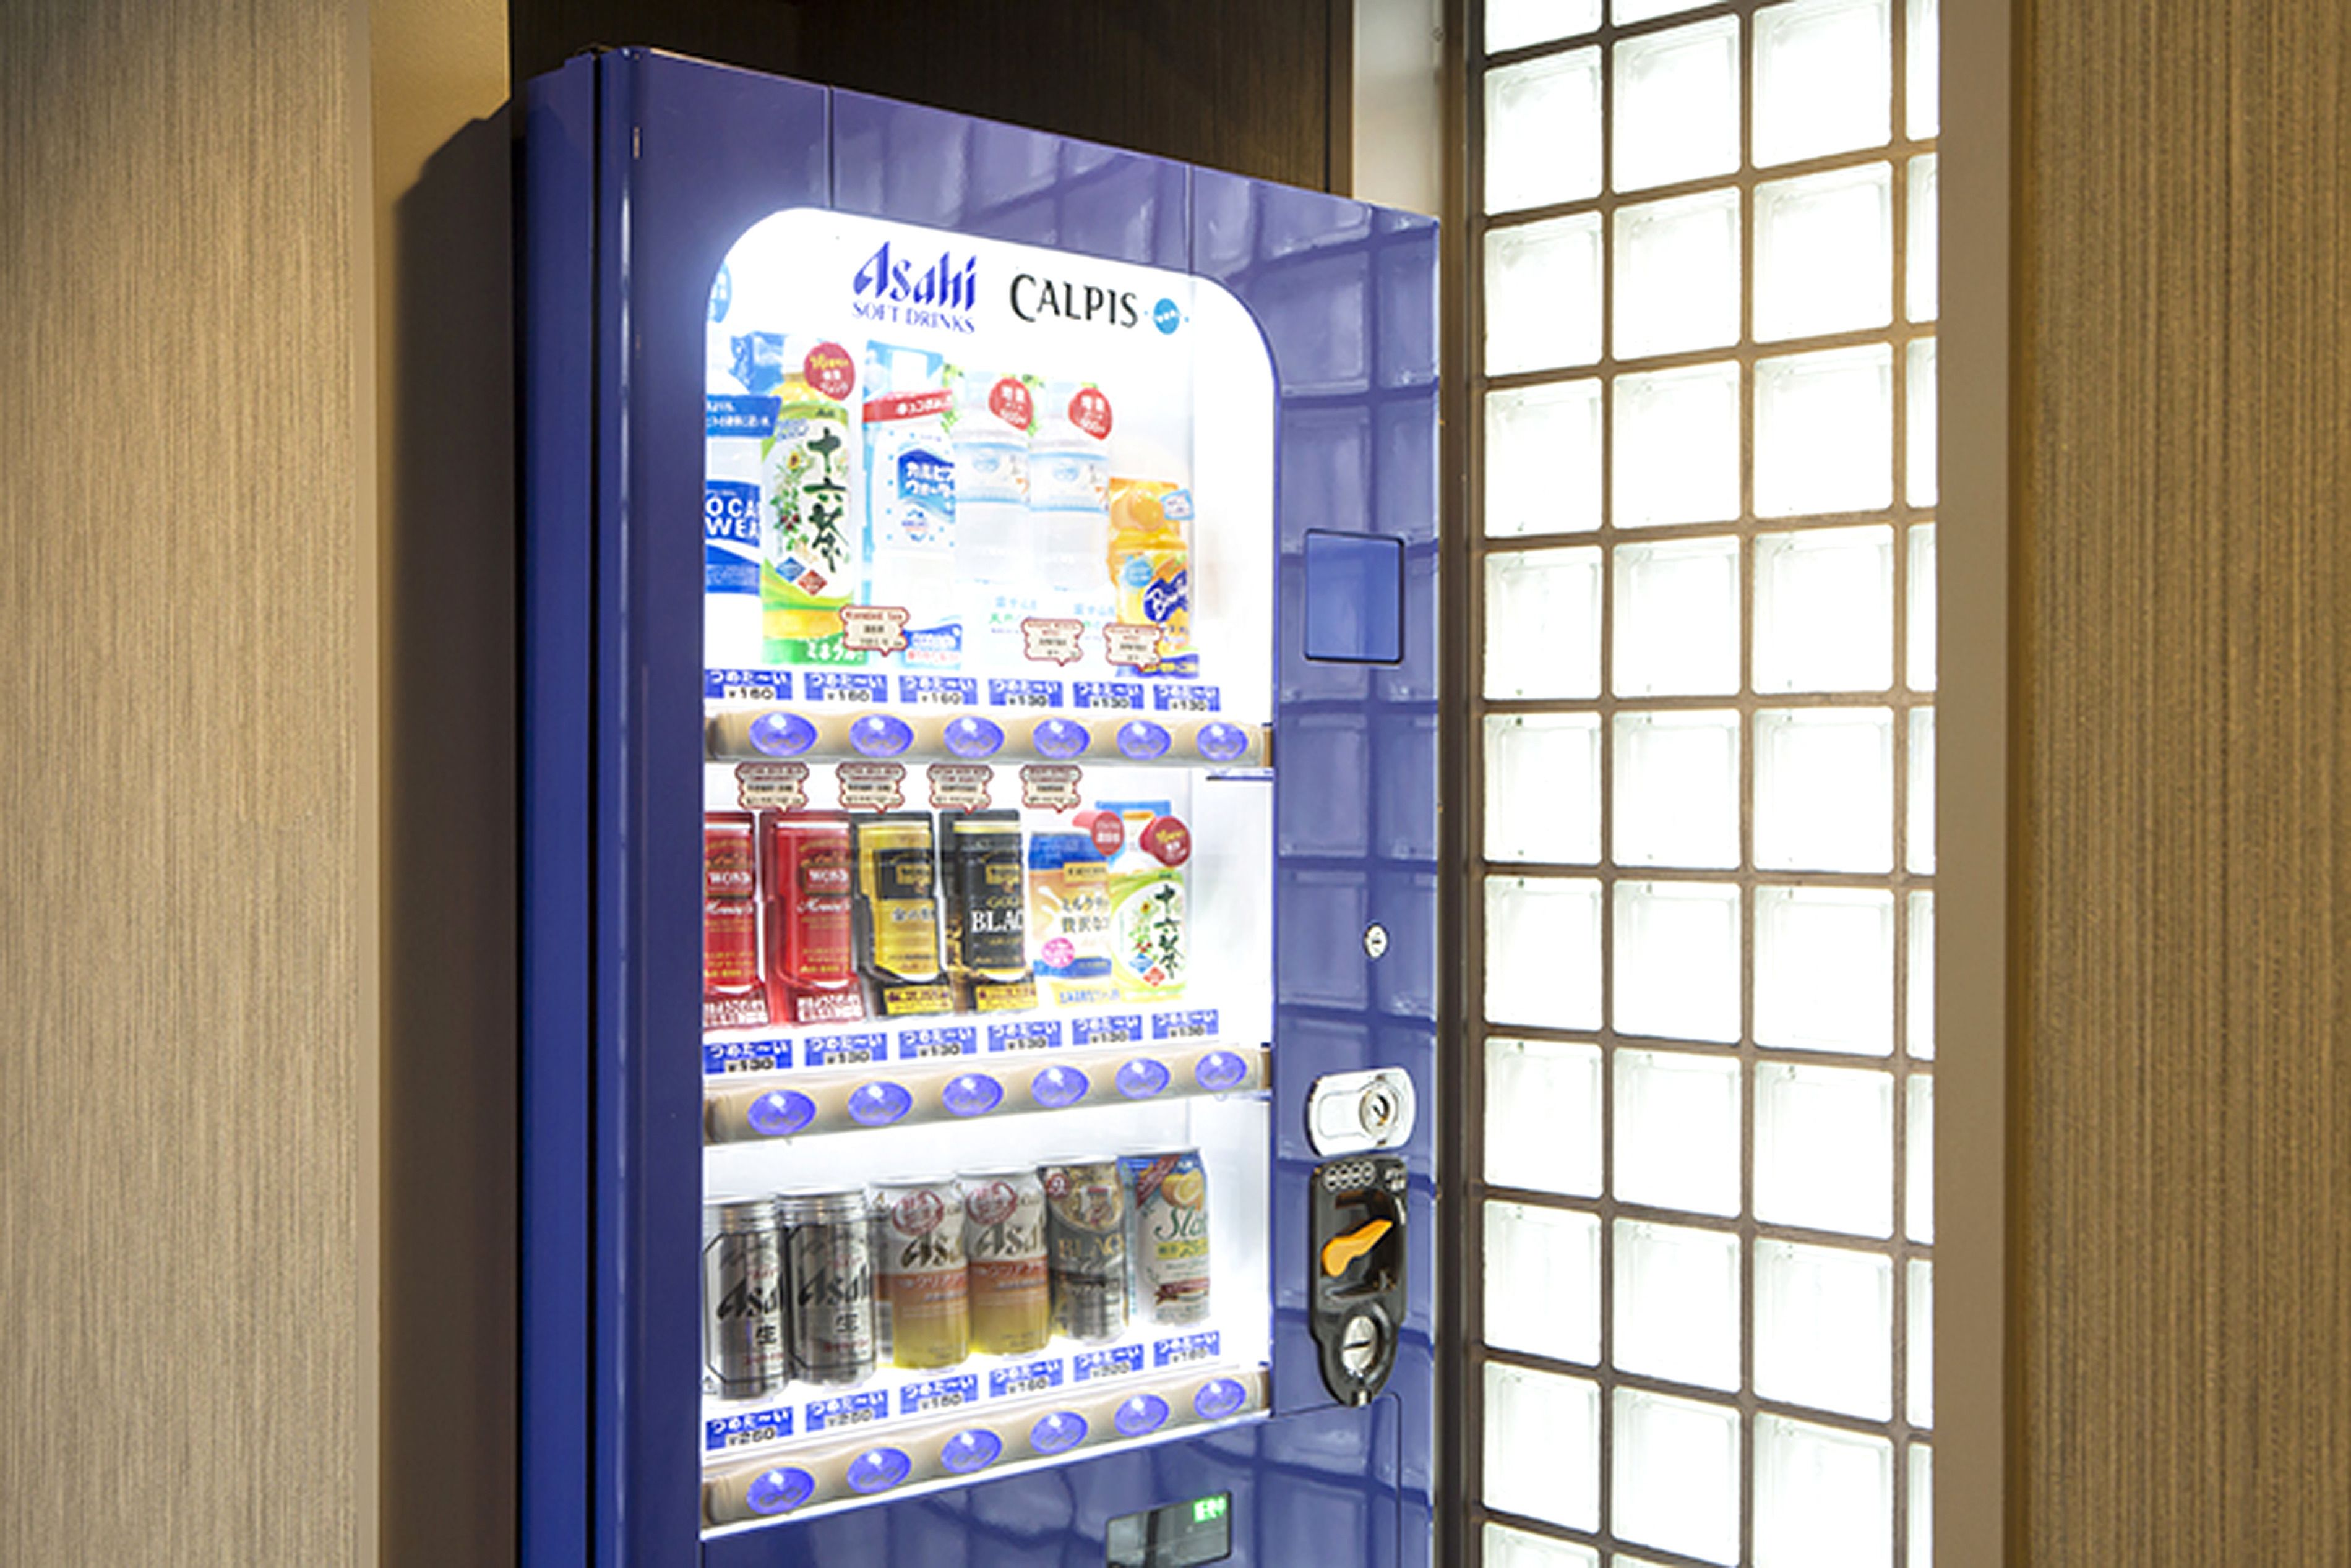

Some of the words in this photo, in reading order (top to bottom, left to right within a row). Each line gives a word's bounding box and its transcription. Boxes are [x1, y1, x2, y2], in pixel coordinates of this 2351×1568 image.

[853, 241, 976, 312] Asahi
[1010, 273, 1138, 329] CALPIS
[853, 299, 897, 328] SOFT
[906, 304, 975, 333] DRINKS
[802, 427, 849, 573] 十六茶
[1153, 883, 1186, 979] 十六茶
